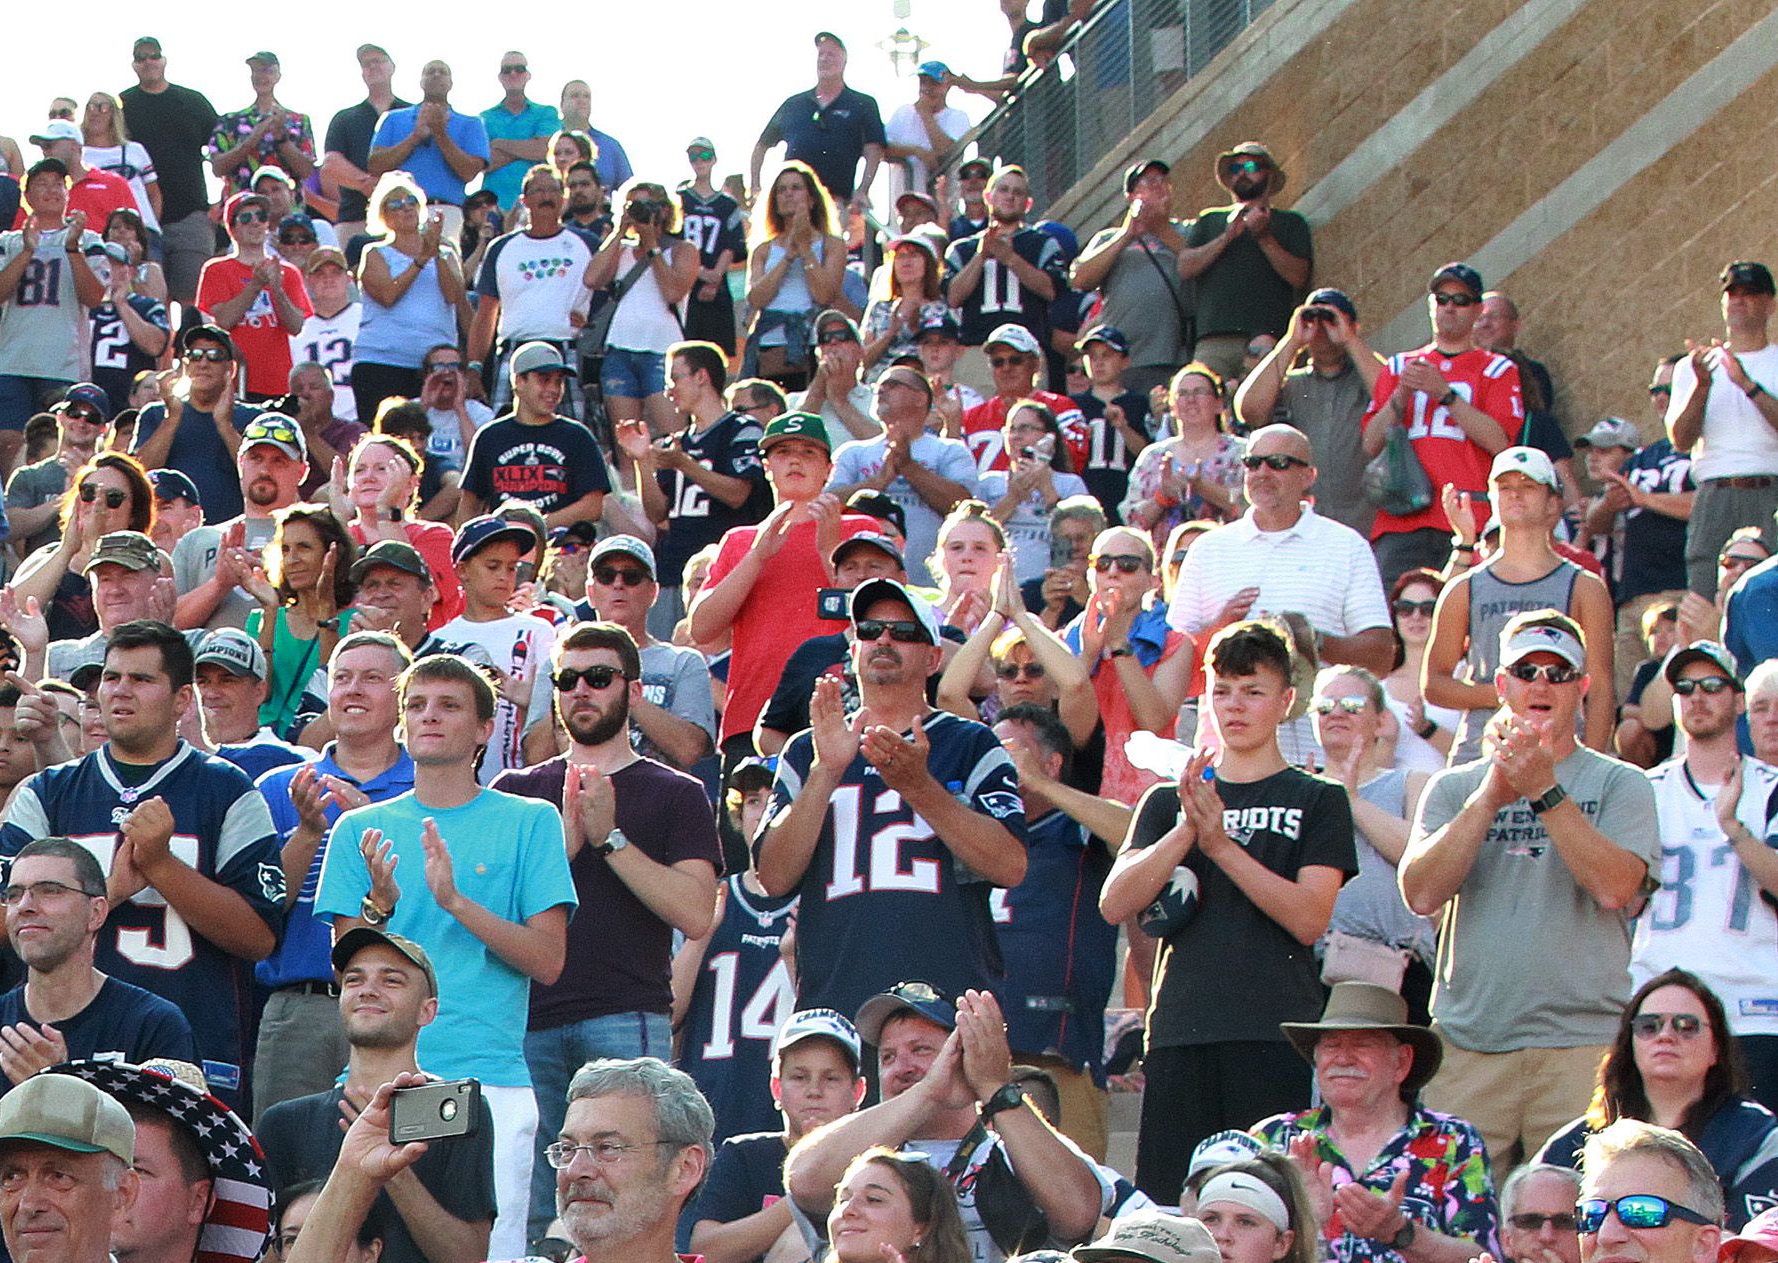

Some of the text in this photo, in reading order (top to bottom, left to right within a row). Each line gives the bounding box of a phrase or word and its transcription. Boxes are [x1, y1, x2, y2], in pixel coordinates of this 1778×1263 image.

[684, 214, 721, 255] 87
[980, 257, 1023, 313] 11
[784, 415, 806, 433] S
[498, 442, 534, 466] SUPER
[826, 783, 942, 901] 12
[1222, 806, 1304, 842] RIOTS
[712, 951, 798, 1061] 14
